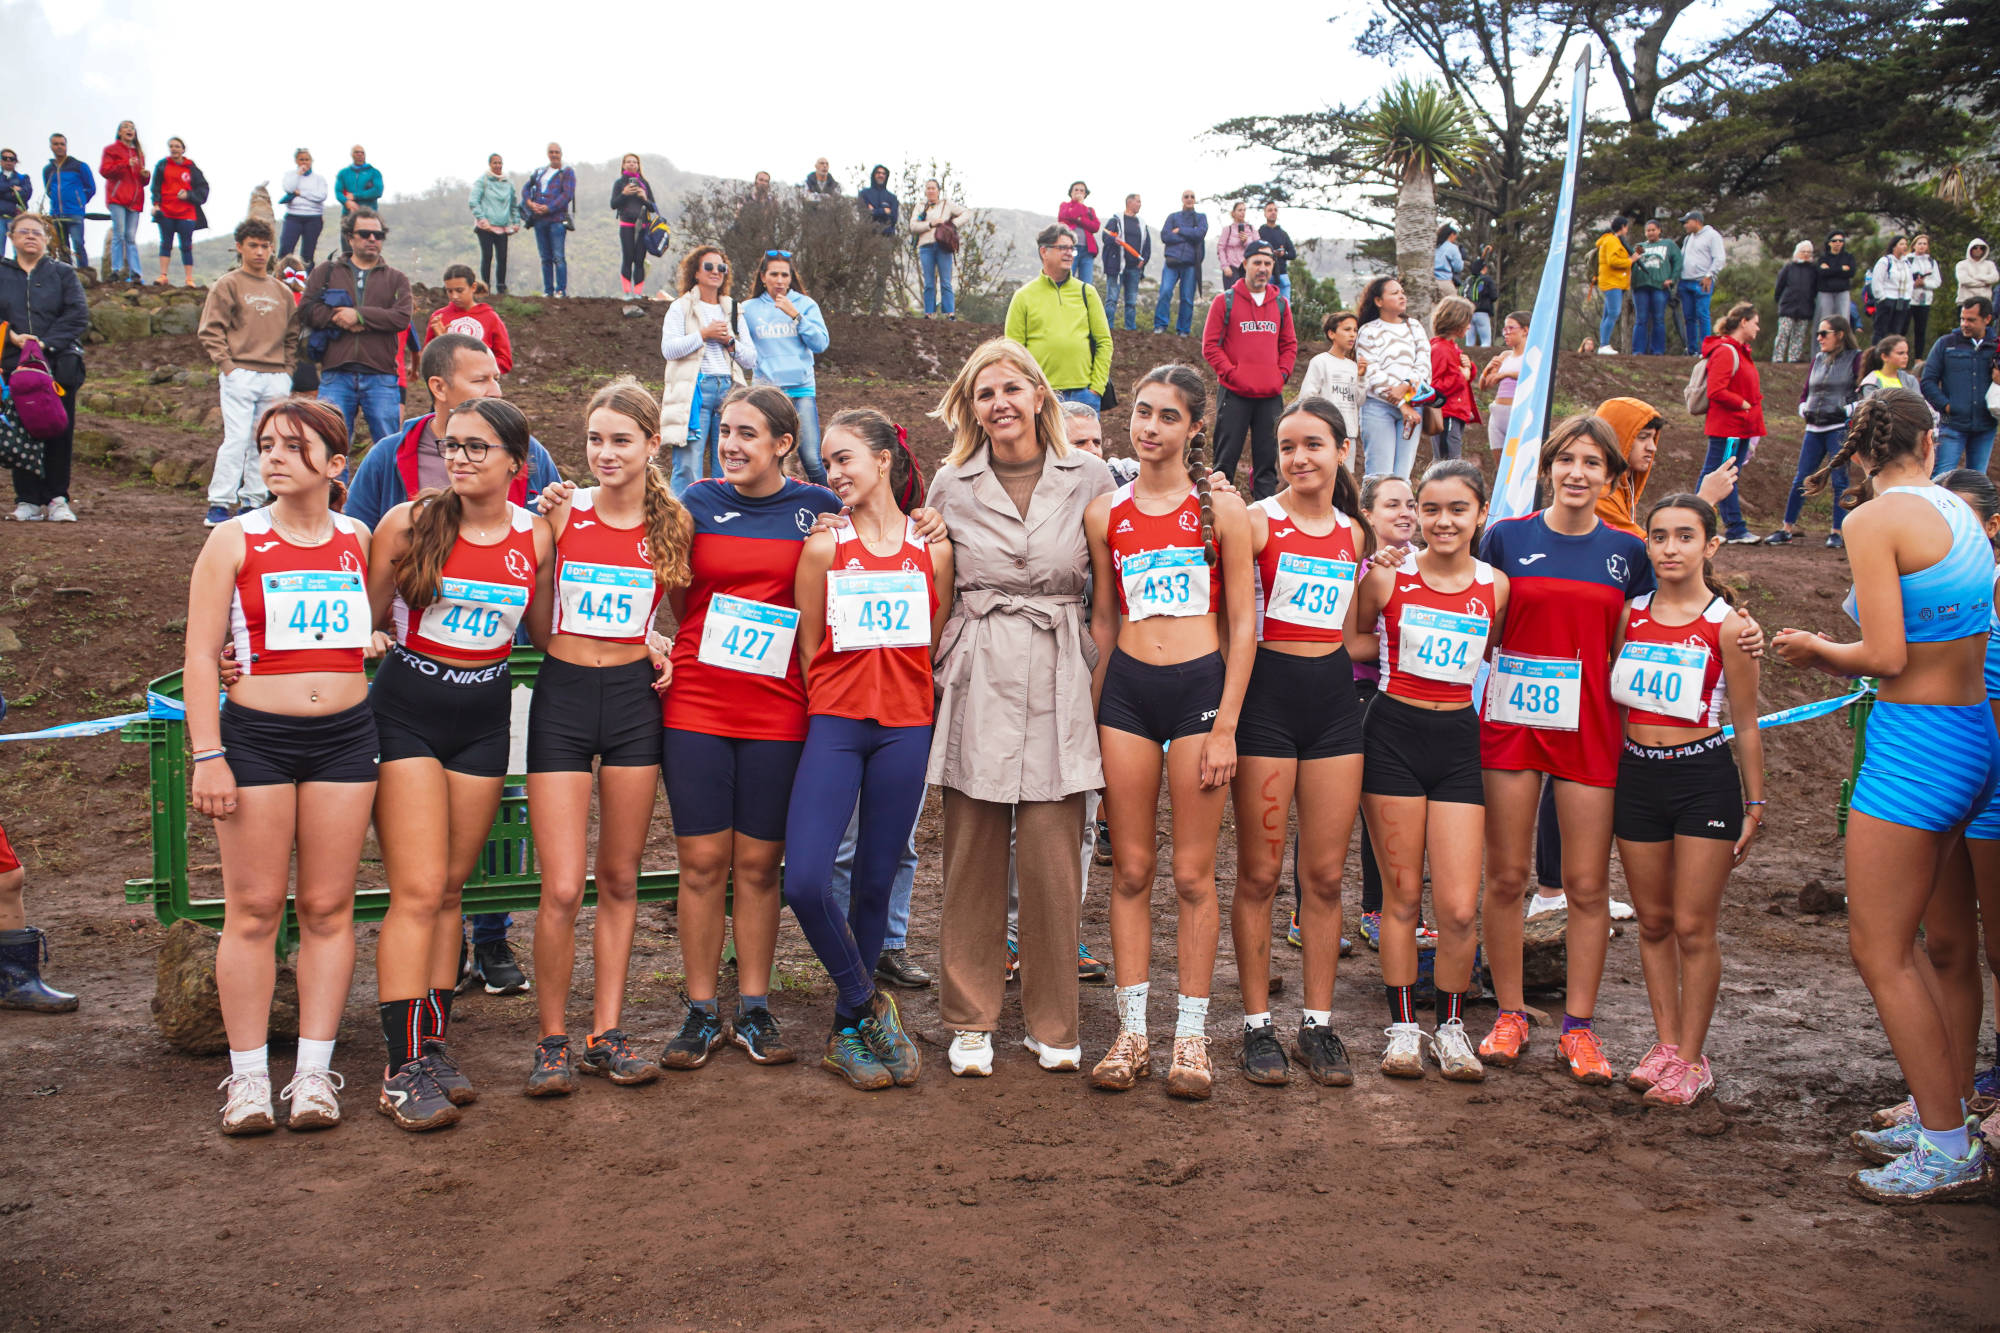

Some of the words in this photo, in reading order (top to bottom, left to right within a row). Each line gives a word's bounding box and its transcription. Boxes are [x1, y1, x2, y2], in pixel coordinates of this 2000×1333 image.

[1142, 573, 1190, 604] 433
[1289, 582, 1339, 615] 439
[288, 599, 349, 633] 443
[441, 605, 503, 637] 446
[577, 591, 633, 624] 445
[858, 599, 910, 631] 432
[721, 625, 775, 661] 427
[1416, 635, 1468, 670] 434
[442, 666, 497, 684] NIKE
[1629, 668, 1682, 703] 440
[1509, 682, 1560, 714] 438
[1201, 709, 1219, 721] JO
[1676, 742, 1705, 758] FILA
[1707, 819, 1726, 828] FILA
